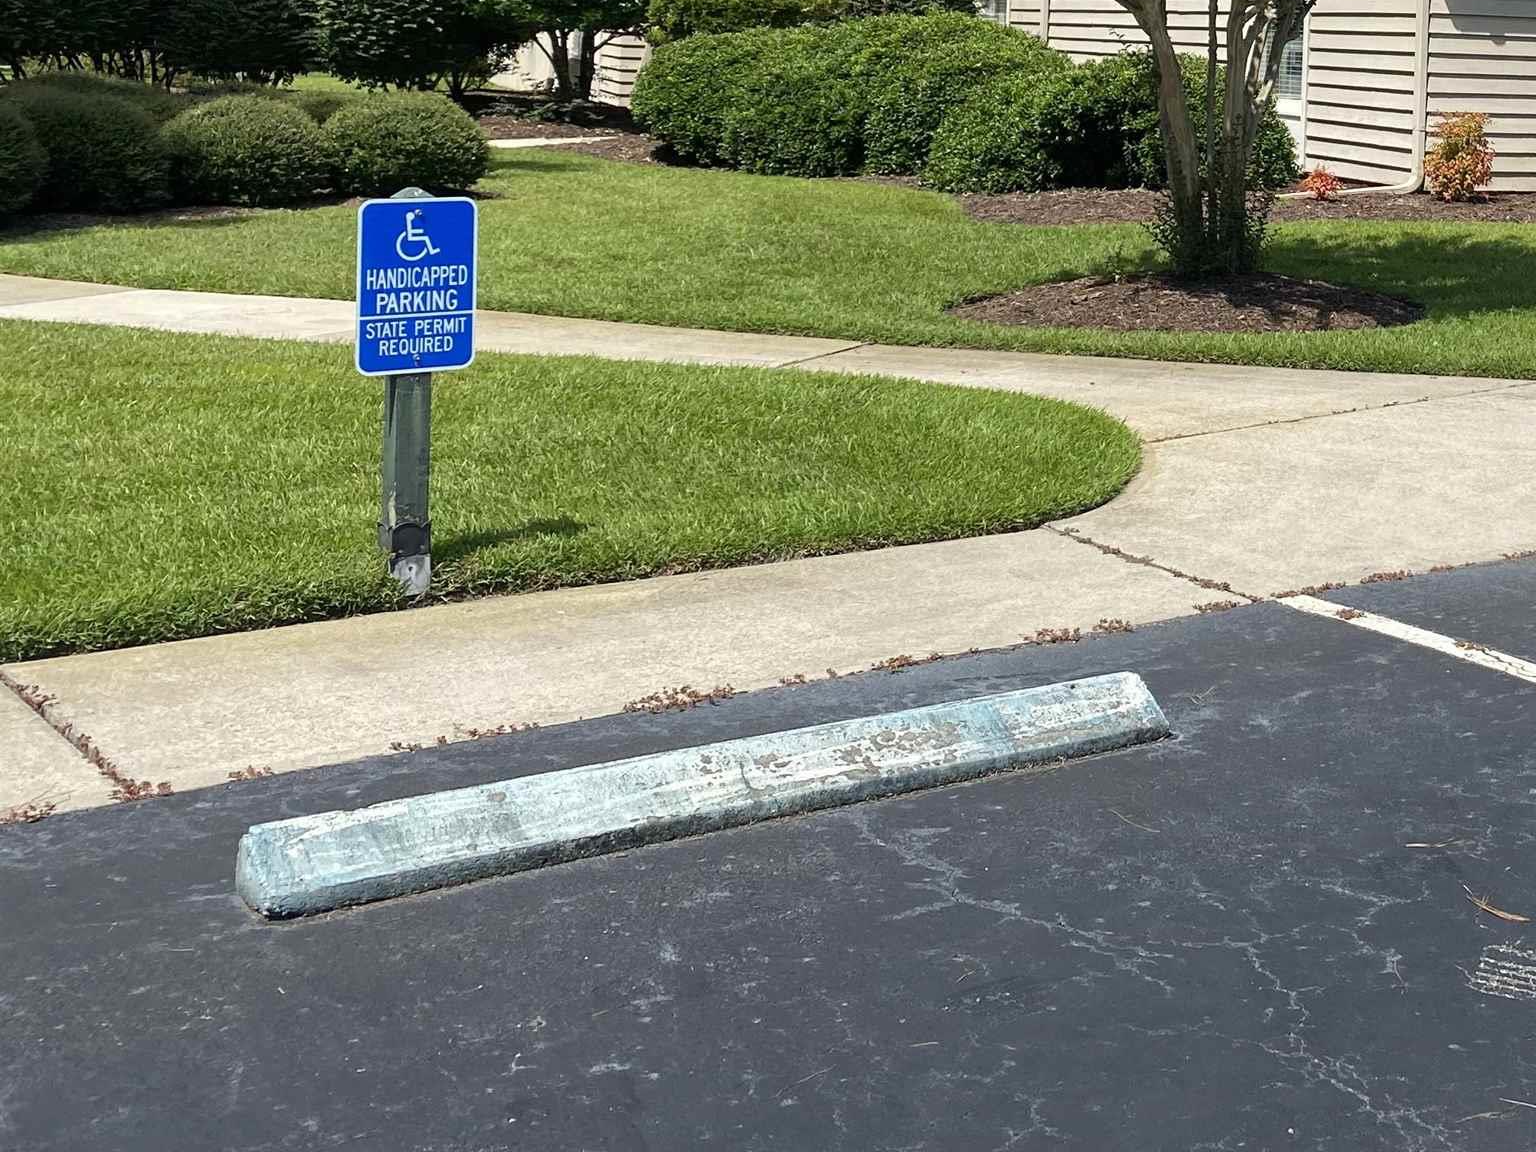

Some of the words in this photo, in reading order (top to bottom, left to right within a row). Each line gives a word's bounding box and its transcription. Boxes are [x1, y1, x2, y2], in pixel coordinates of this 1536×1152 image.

[366, 265, 468, 290] HANDICAPPED
[376, 289, 458, 314] PARKING
[366, 321, 408, 339] STATE
[415, 317, 467, 336] PERMIT
[379, 336, 454, 356] REQUIRED
